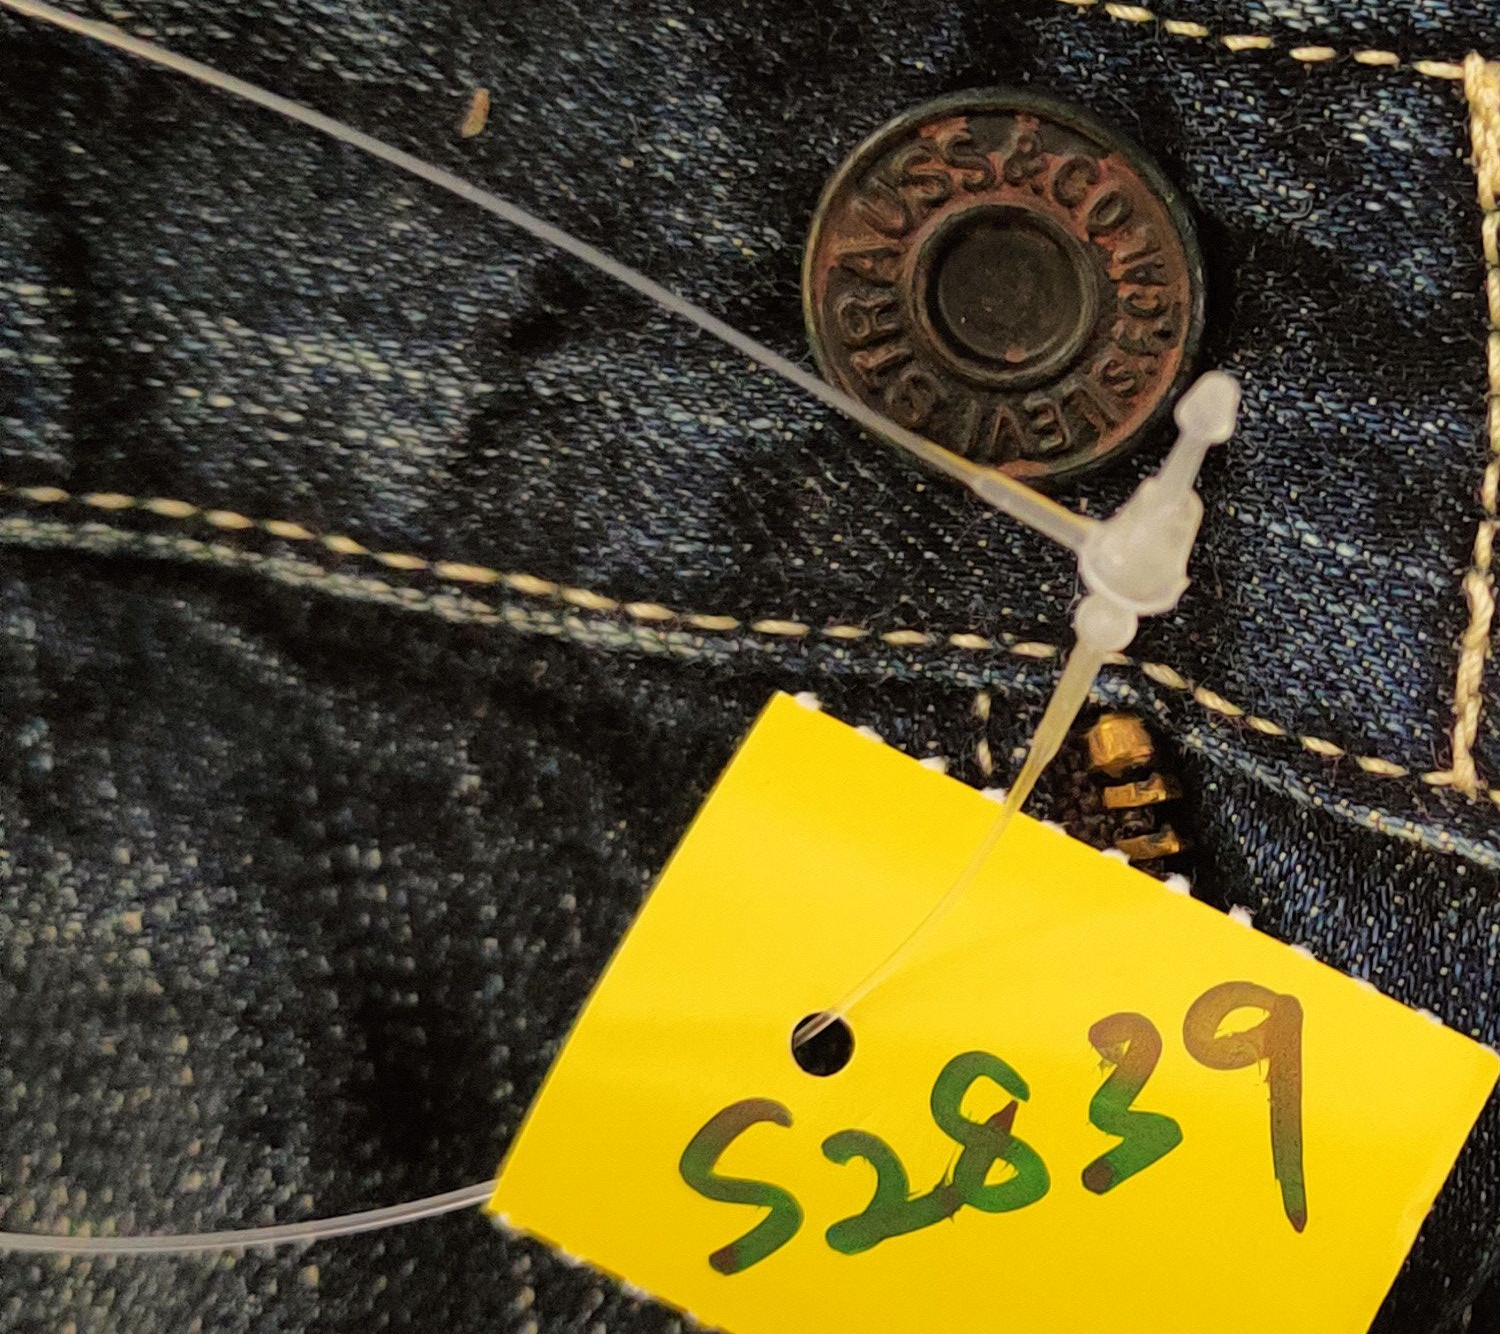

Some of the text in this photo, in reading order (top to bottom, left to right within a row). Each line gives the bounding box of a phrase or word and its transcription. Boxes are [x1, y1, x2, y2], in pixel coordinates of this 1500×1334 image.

[1003, 130, 1048, 196] &
[836, 134, 997, 429] STRAUSS
[962, 375, 1120, 459] LEVI
